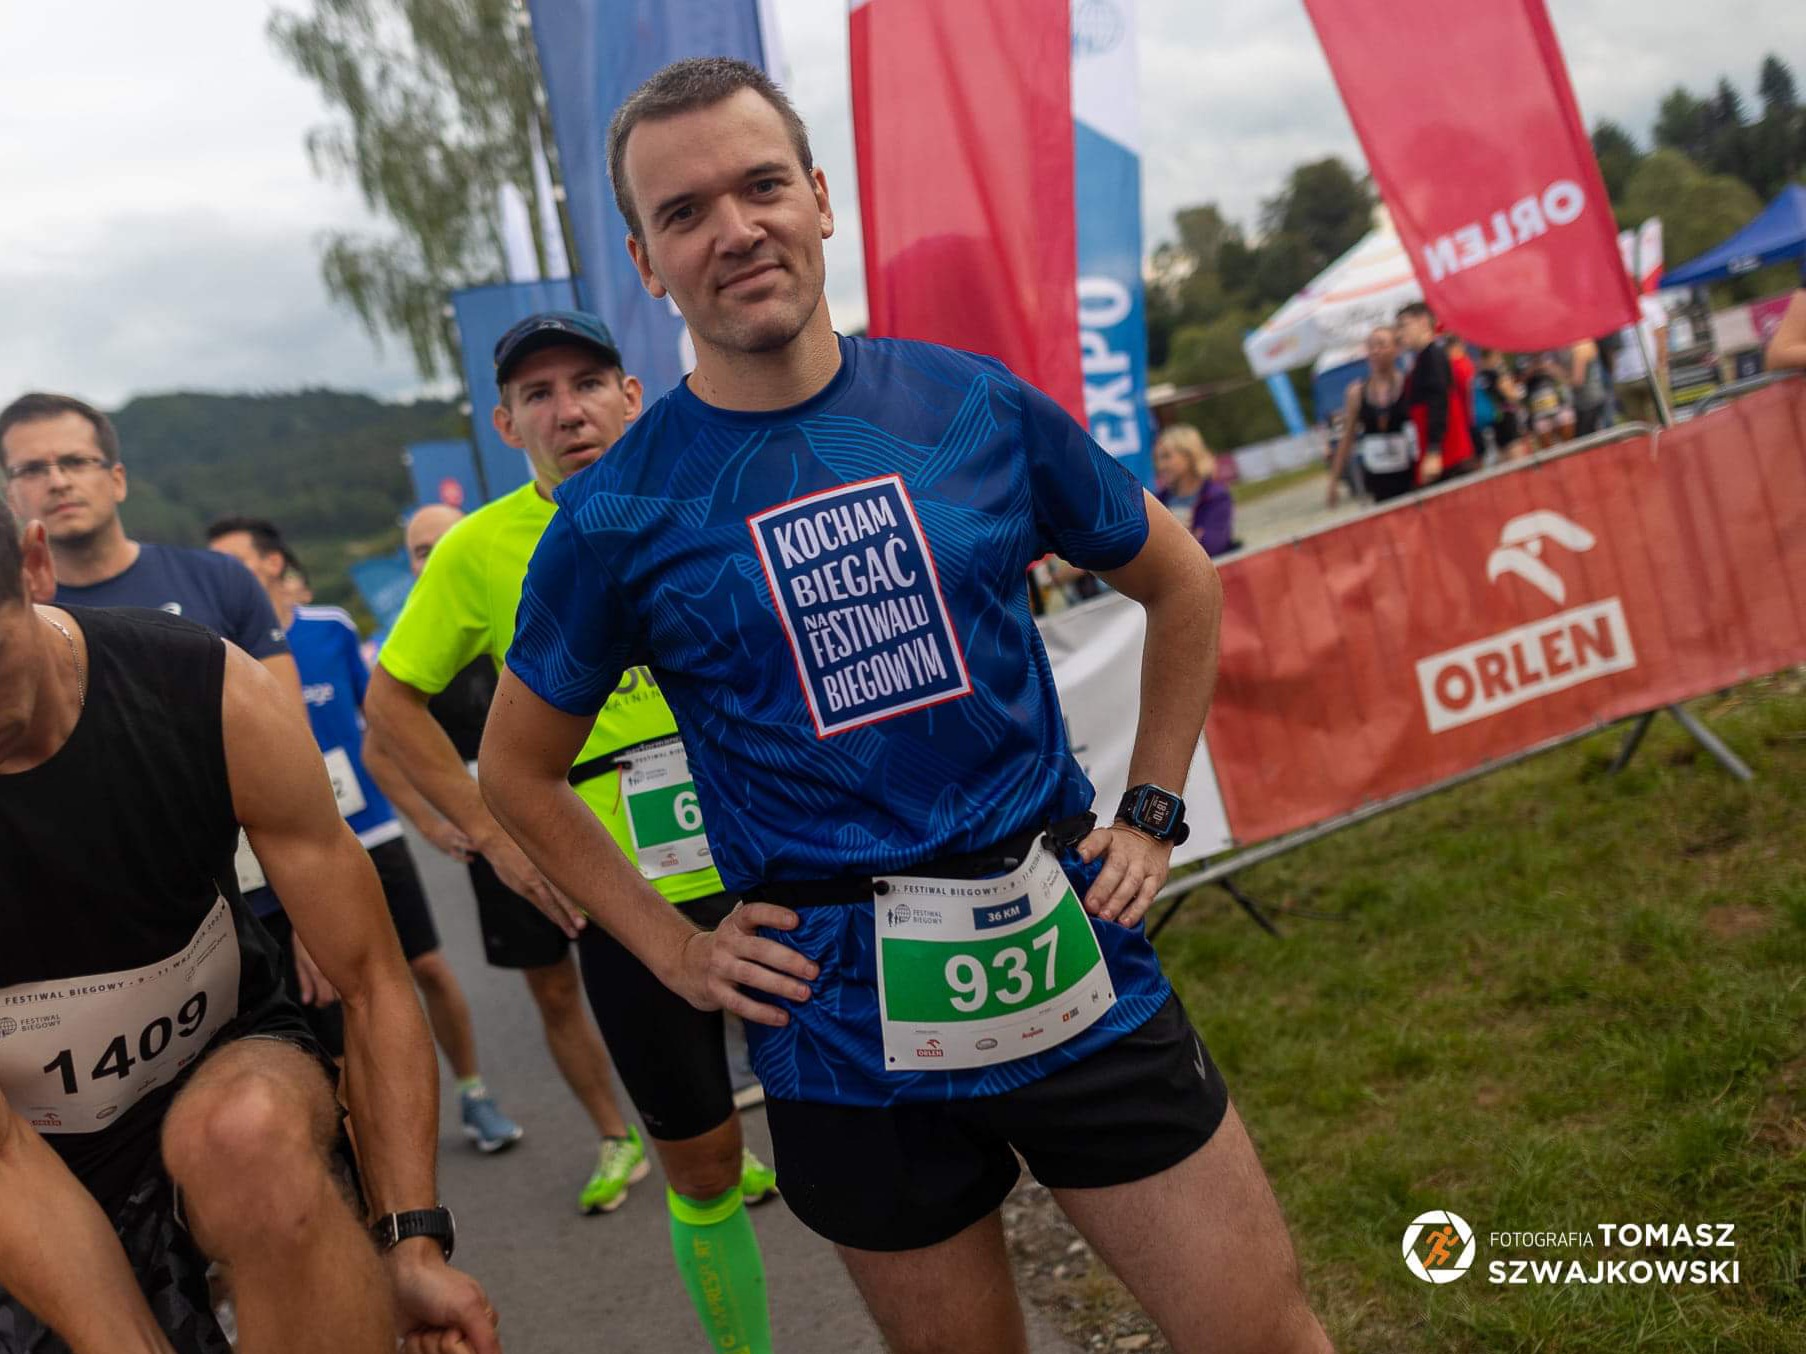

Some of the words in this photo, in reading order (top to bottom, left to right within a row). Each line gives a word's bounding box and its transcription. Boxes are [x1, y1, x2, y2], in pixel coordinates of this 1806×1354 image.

[1076, 276, 1142, 457] EXPO
[773, 495, 898, 569] KOCHAM
[790, 533, 916, 608] BIEGAĆ
[803, 612, 829, 632] NA
[807, 594, 930, 669] FESTIWALU
[821, 632, 948, 713] BIEGOWYM
[1434, 614, 1618, 714] ORLEN
[904, 884, 947, 895] FESTIWAL
[950, 886, 999, 896] BIEGOWY
[987, 908, 1003, 923] 36
[1003, 905, 1021, 920] KM
[5, 991, 65, 1006] FESTIWAL
[69, 981, 125, 997] BIEGOWY
[943, 925, 1060, 1013] 937
[21, 1013, 61, 1026] FESTIWAL
[21, 1020, 61, 1032] BIEGOWY
[43, 990, 208, 1095] 1409
